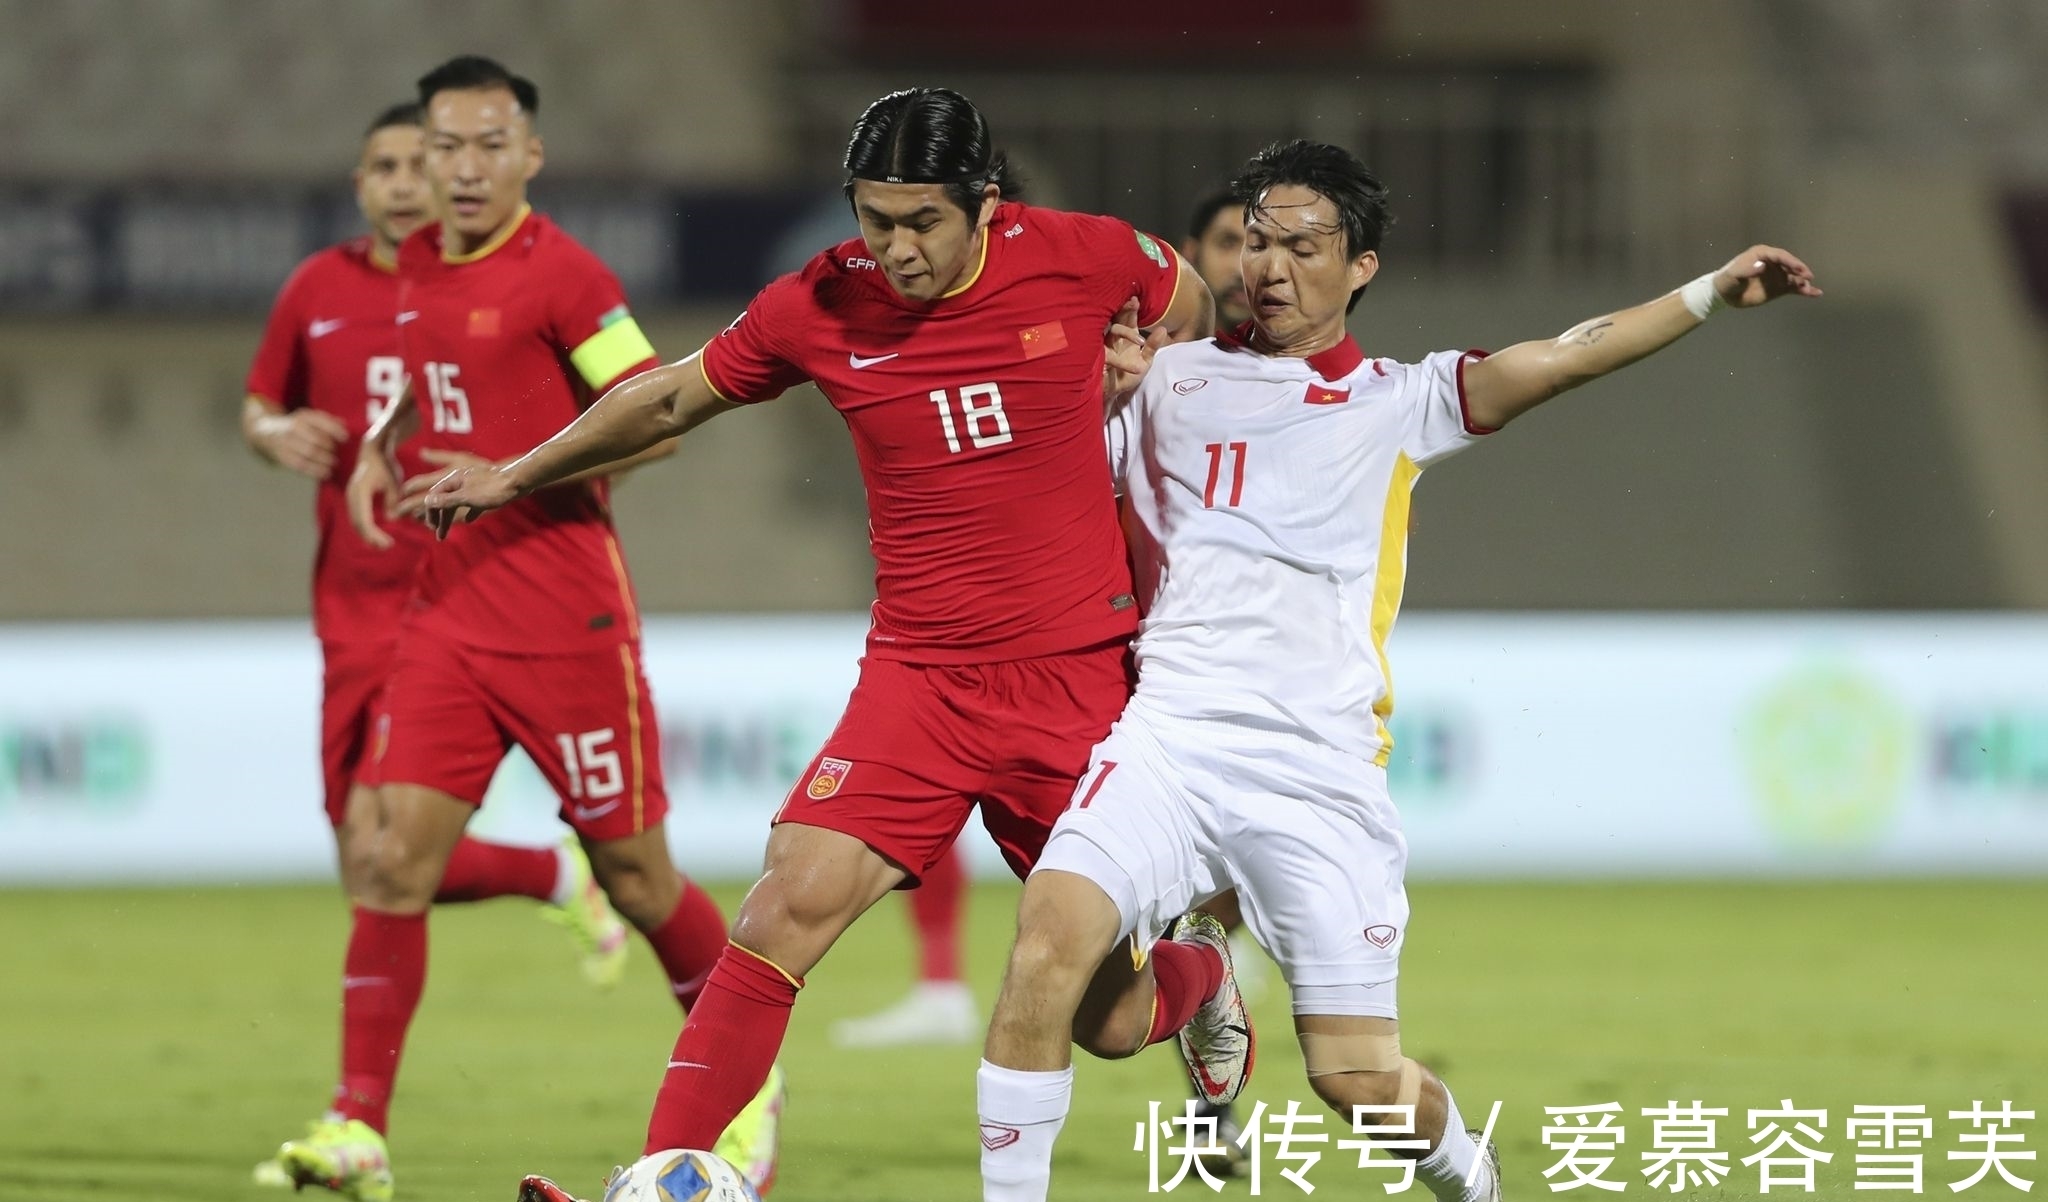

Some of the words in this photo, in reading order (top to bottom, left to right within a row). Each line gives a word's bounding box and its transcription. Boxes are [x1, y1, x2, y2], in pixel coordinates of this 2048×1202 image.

[846, 257, 876, 270] CFA
[366, 355, 404, 428] 9
[423, 361, 473, 434] 15
[929, 381, 1014, 454] 18
[1203, 441, 1247, 509] 11
[556, 727, 625, 799] 15
[822, 761, 847, 772] CFA
[1064, 759, 1119, 811] 1
